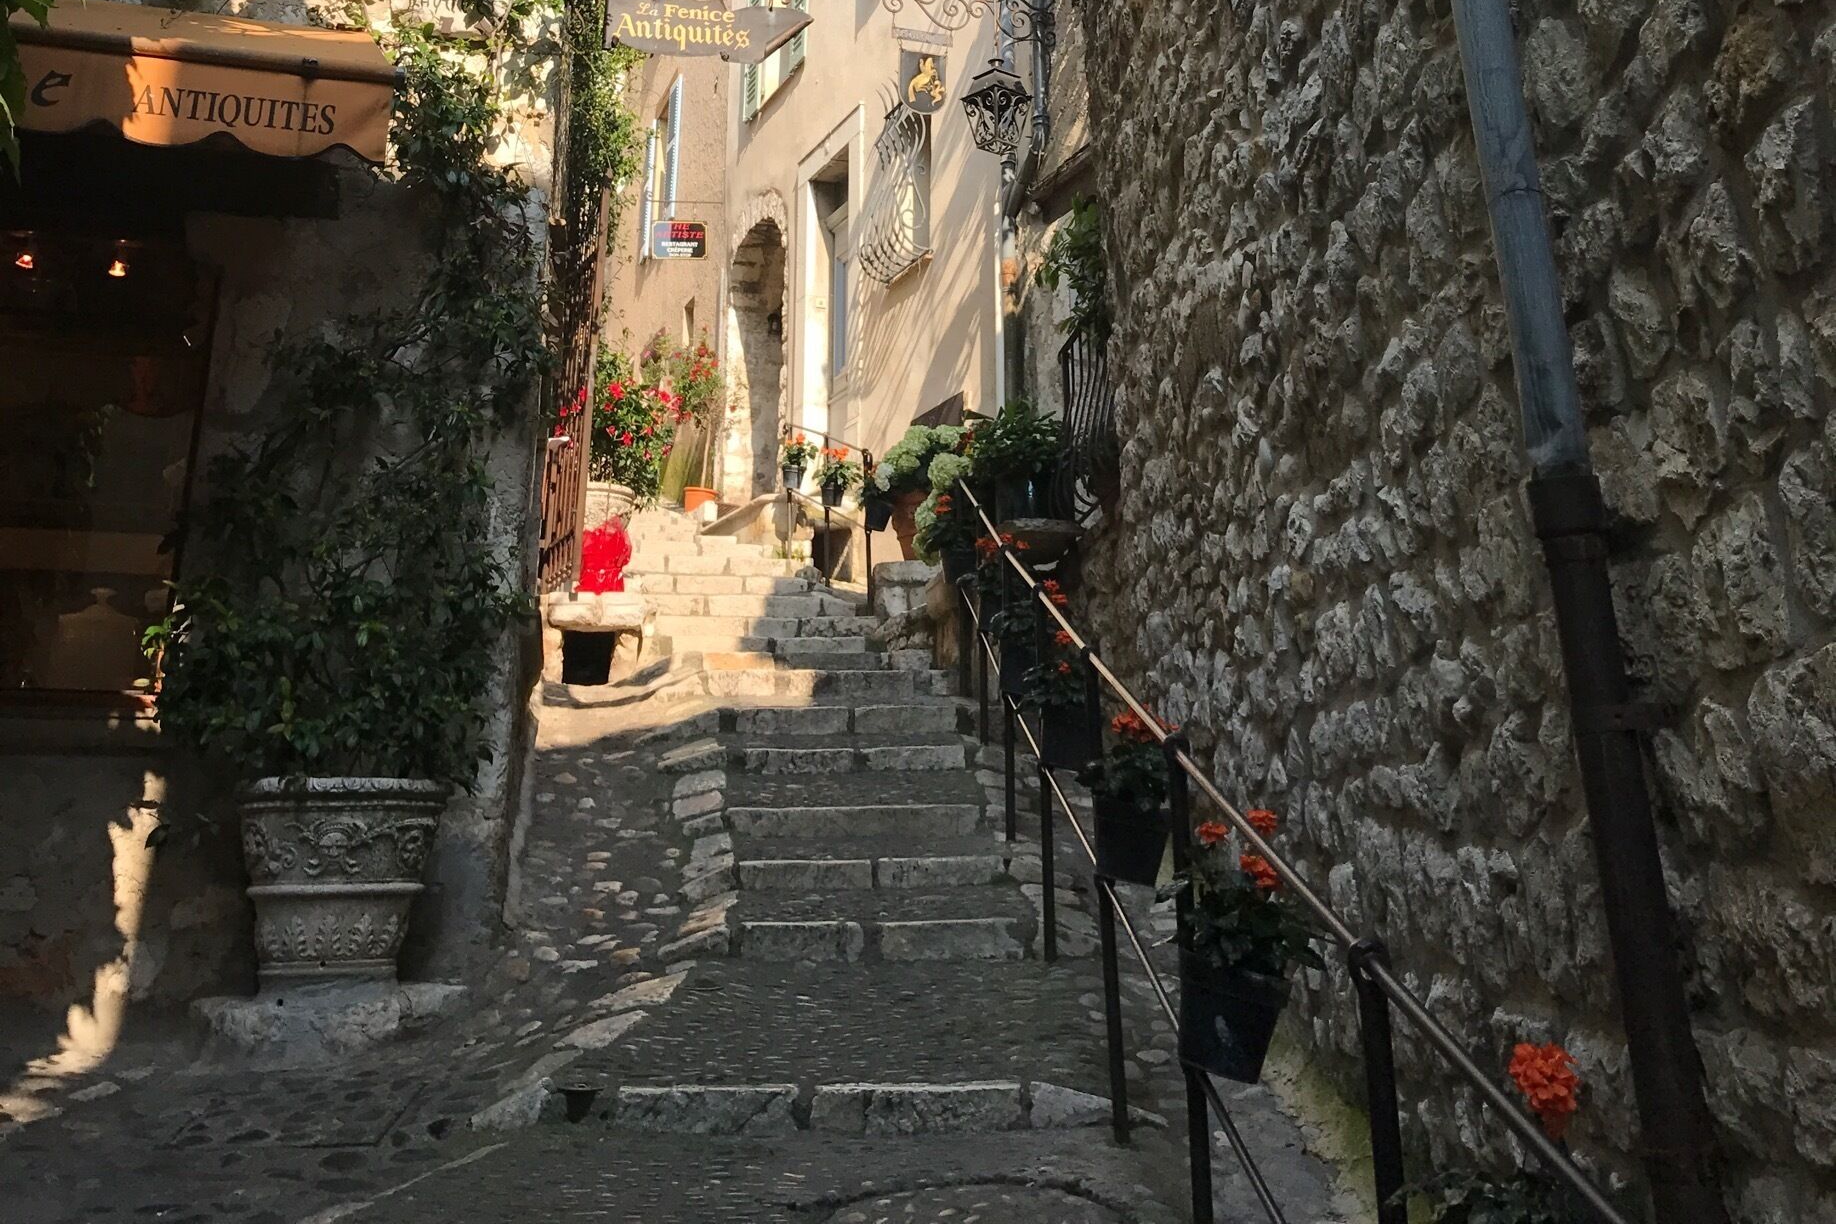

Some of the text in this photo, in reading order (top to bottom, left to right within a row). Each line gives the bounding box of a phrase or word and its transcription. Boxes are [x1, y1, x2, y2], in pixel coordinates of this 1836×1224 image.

[636, 2, 736, 22] La Fenice
[612, 13, 751, 51] Antiquités
[132, 84, 336, 135] ANTIQUITES
